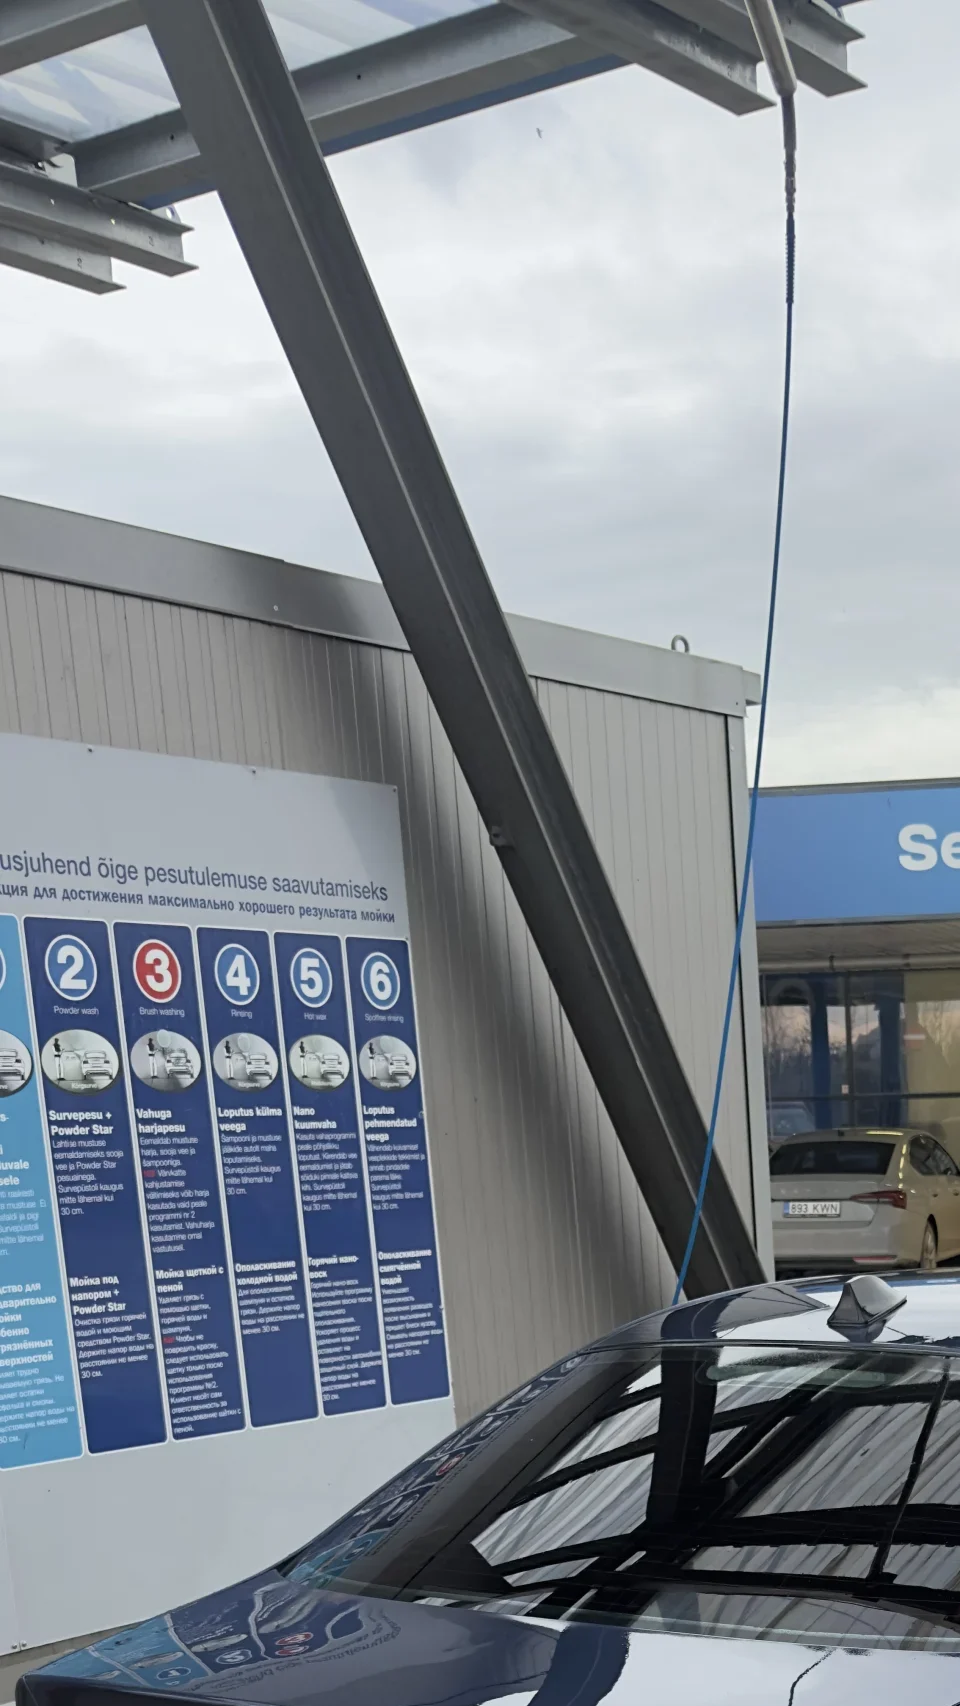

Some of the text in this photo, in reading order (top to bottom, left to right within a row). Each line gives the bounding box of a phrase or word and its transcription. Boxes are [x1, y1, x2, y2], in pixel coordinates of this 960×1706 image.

[98, 858, 138, 884] õige
[145, 866, 267, 891] pesutulemuse
[273, 877, 388, 901] saavutamiseks
[34, 887, 57, 899] для
[62, 888, 144, 904] достижения
[149, 894, 235, 911] максимально
[239, 900, 295, 915] хорошего
[299, 906, 357, 920] результата
[361, 908, 395, 923] мойки
[57, 945, 88, 989] 2
[145, 949, 173, 992] 3
[225, 954, 251, 996] 4
[300, 957, 323, 998] 5
[370, 961, 392, 1000] 6
[54, 1005, 99, 1016] Powder wash
[139, 1006, 185, 1018] Brush washing
[231, 1009, 252, 1019] Rinsing
[49, 1110, 103, 1122] Survepesu
[136, 1108, 172, 1120] Vahuga
[218, 1106, 282, 1118] Loputus külma
[293, 1106, 315, 1115] Nano
[363, 1105, 395, 1116] Loputus
[138, 1123, 186, 1135] harjapesu
[219, 1122, 246, 1133] veega
[294, 1119, 337, 1129] kuumvaha
[364, 1118, 417, 1129] pehmendatud
[51, 1124, 113, 1136] Powder Star
[365, 1132, 389, 1142] veega
[78, 1139, 106, 1147] mustuse
[54, 1150, 124, 1159] eemaldamiseks sooja
[160, 1147, 177, 1156] sooja
[55, 1161, 116, 1172] vee ja Powder Star
[58, 1183, 124, 1193] Survepüstoli kaugus
[226, 1187, 235, 1195] 30
[60, 1196, 76, 1204] mitte
[77, 1195, 103, 1203] lähemal
[61, 1207, 70, 1215] 30
[791, 1203, 838, 1213] 893 KWN
[148, 1211, 182, 1222] programmi
[235, 1260, 296, 1272] Ополаскивание
[308, 1255, 338, 1267] Горячий
[155, 1265, 224, 1279] Мойка щеткой с
[309, 1270, 327, 1279] воск
[69, 1276, 119, 1288] Мойка под
[237, 1271, 298, 1285] холодной водой
[25, 1282, 41, 1293] для
[157, 1282, 183, 1293] пеной
[71, 1290, 112, 1301] напором
[73, 1302, 126, 1315] Powder Star
[74, 1317, 101, 1326] Очистка
[121, 1312, 147, 1322] горячей
[75, 1328, 96, 1337] водой
[112, 1335, 135, 1344] Powder
[81, 1371, 91, 1379] 30
